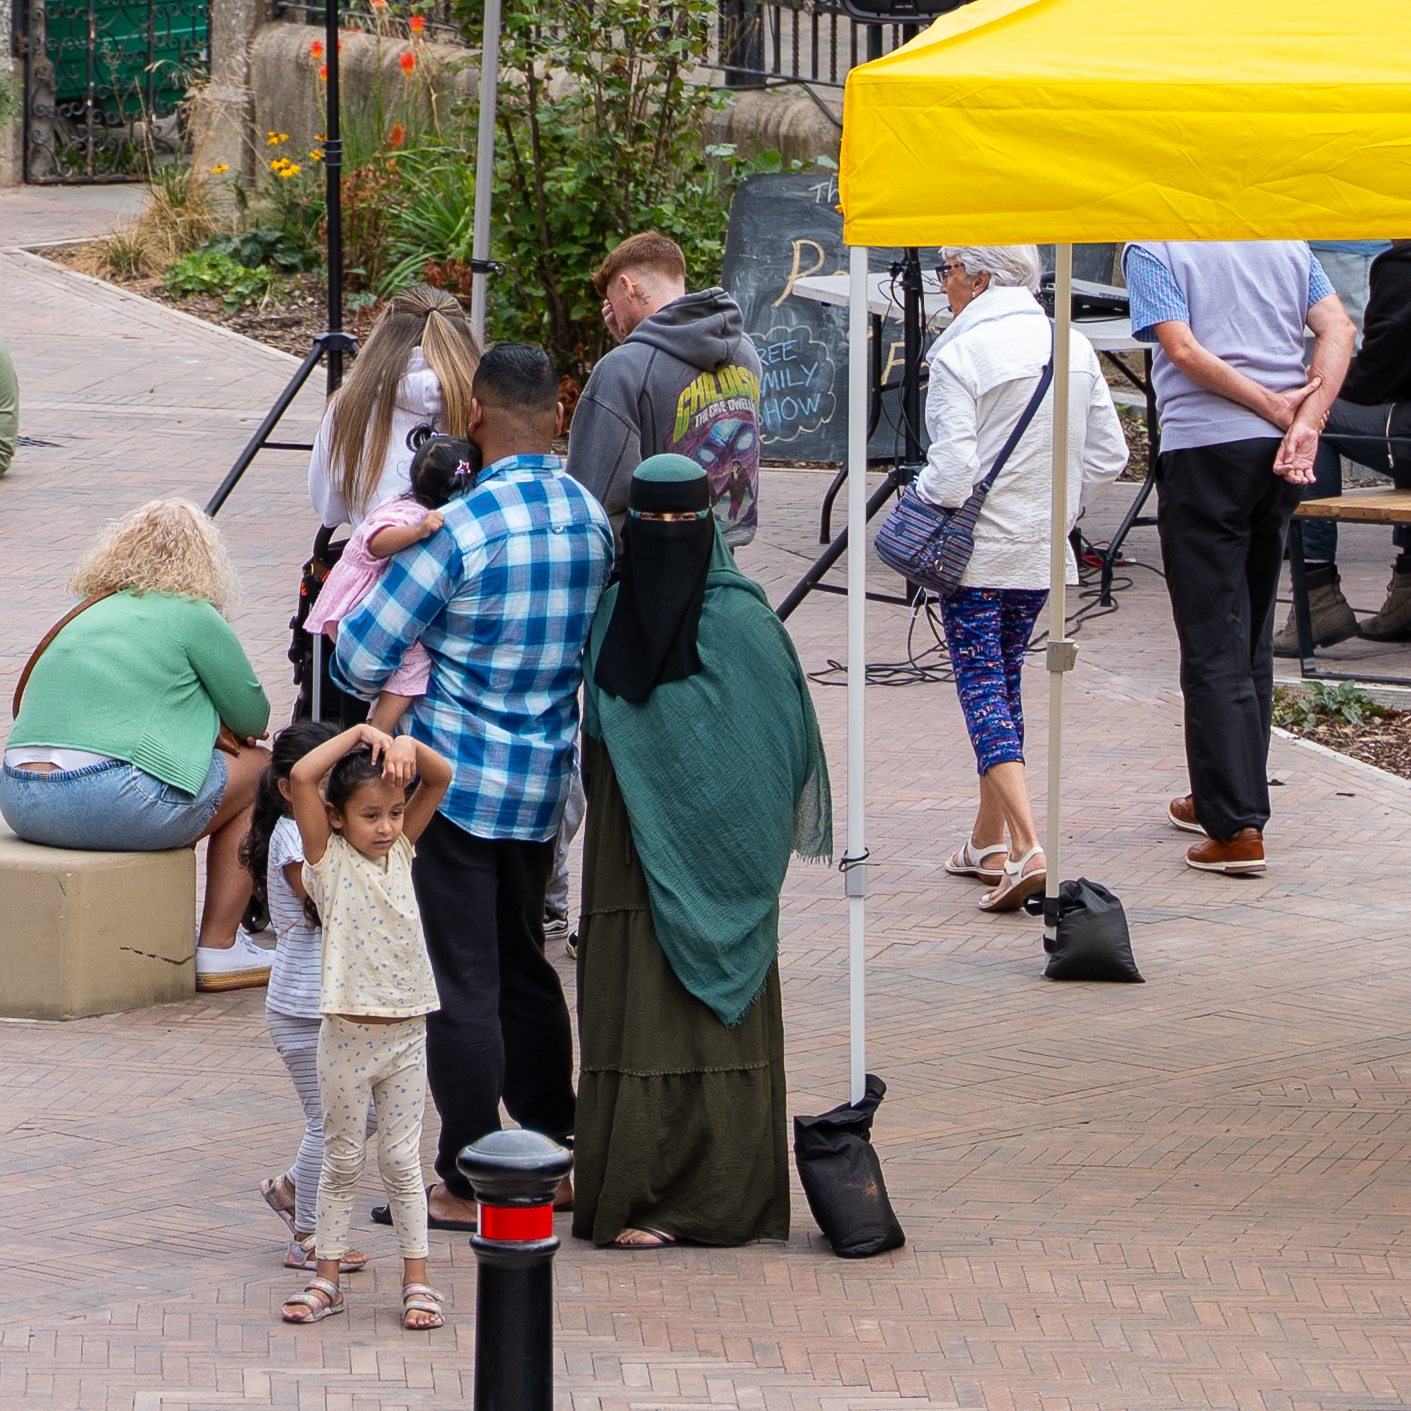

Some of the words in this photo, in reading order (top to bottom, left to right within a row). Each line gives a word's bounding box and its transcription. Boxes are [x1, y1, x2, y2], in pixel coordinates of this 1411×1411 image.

[756, 339, 798, 366] REE
[761, 361, 819, 398] MILY
[694, 408, 710, 428] THE
